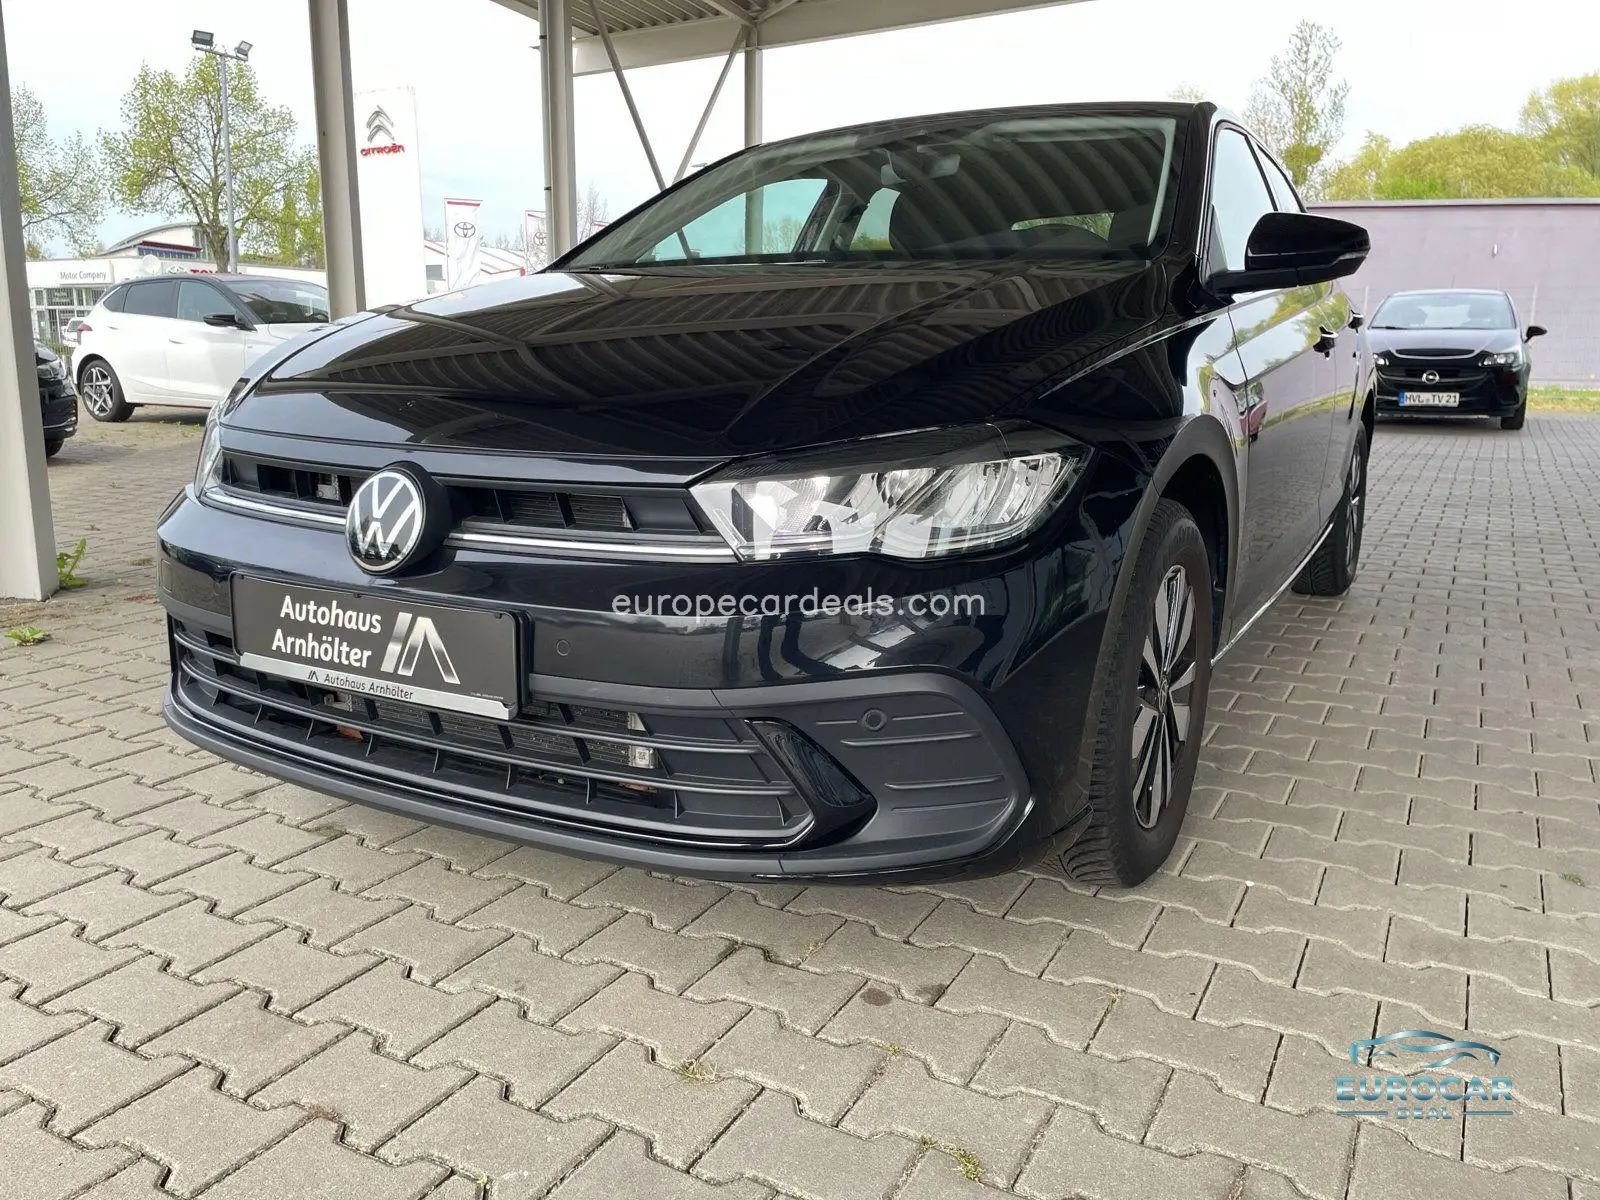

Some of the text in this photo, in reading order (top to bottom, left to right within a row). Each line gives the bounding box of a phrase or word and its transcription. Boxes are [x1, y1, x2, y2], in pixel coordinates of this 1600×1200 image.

[60, 271, 106, 280] Motor Company
[1446, 395, 1457, 403] 21
[280, 595, 382, 634] Autohaus
[271, 628, 372, 668] Arnhölter
[324, 673, 414, 700] Autohaus Arnhölter
